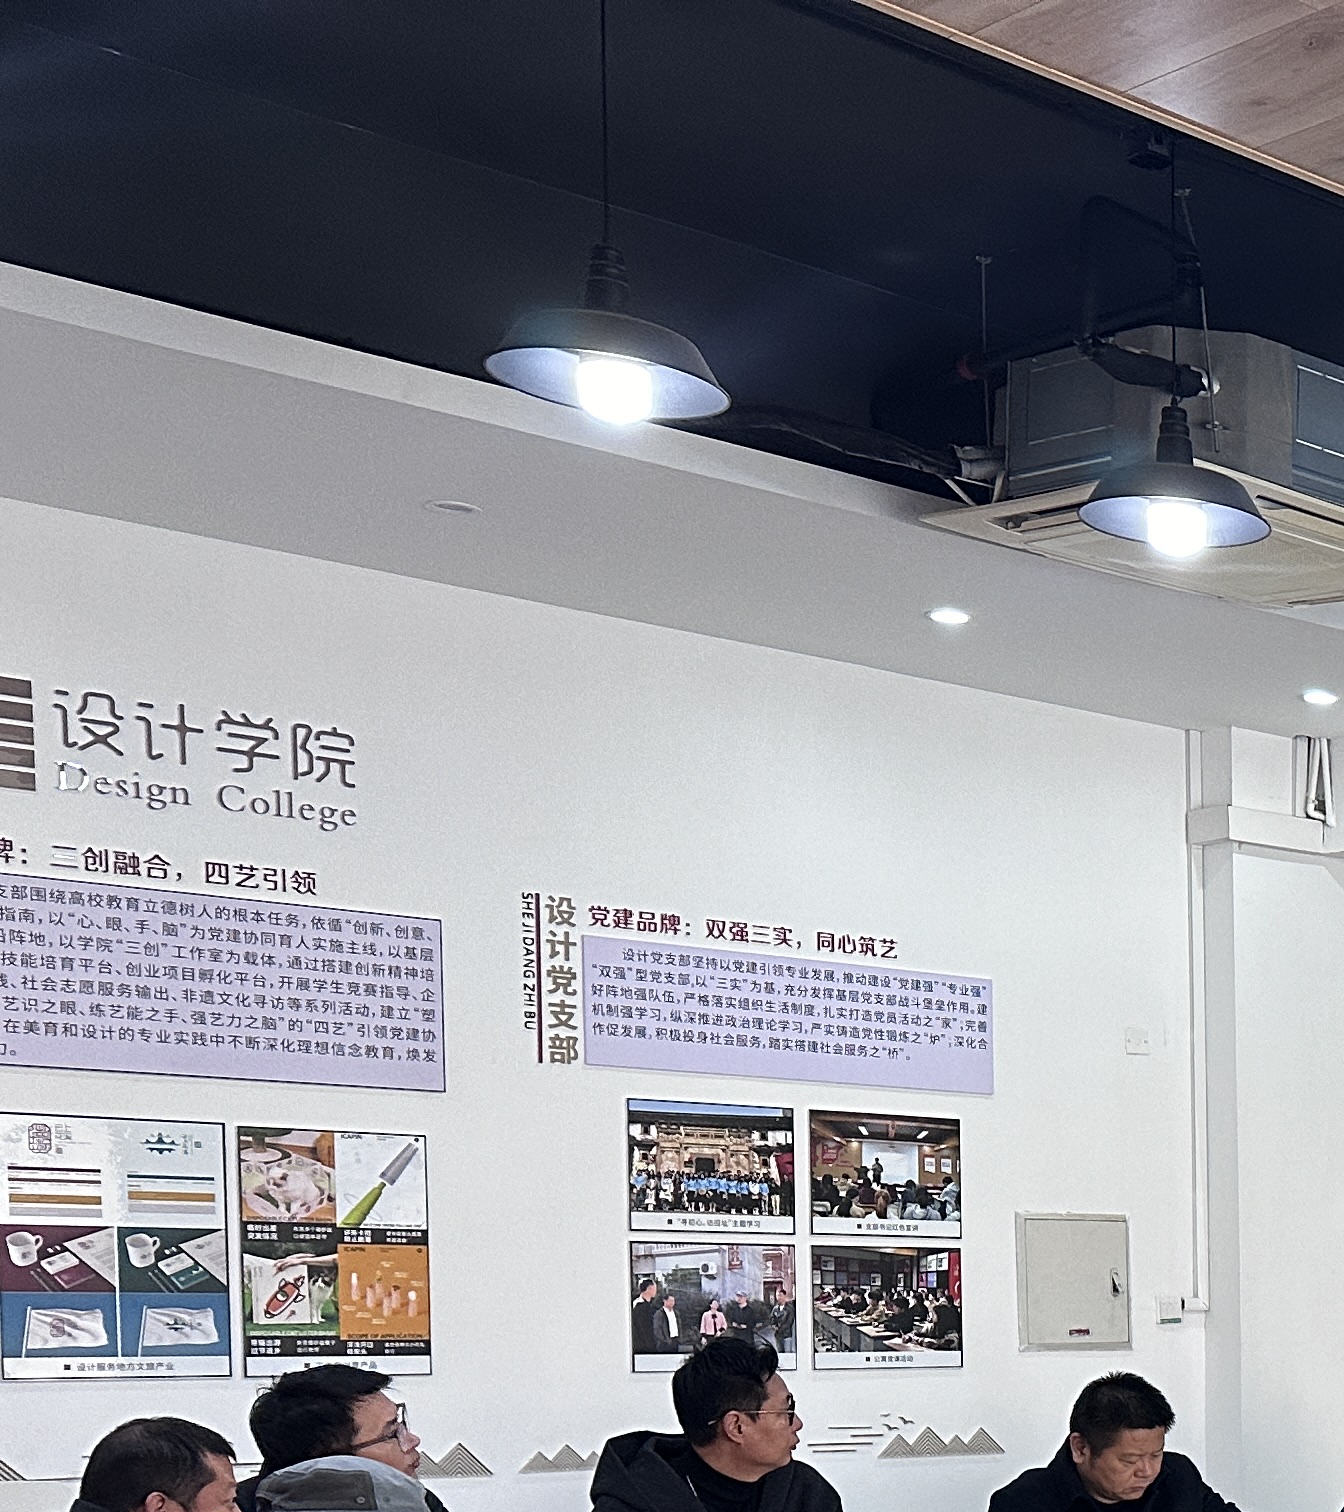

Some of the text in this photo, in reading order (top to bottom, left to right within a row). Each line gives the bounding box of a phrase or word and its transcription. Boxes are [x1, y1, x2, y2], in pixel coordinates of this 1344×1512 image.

[52, 688, 357, 789] 设计学院
[56, 761, 358, 832] Design College
[521, 891, 537, 1030] SHE JI DANG ZHI BU
[545, 894, 579, 1065] 设计党支部
[587, 904, 899, 960] 党建品牌：双强三实，同心筑艺
